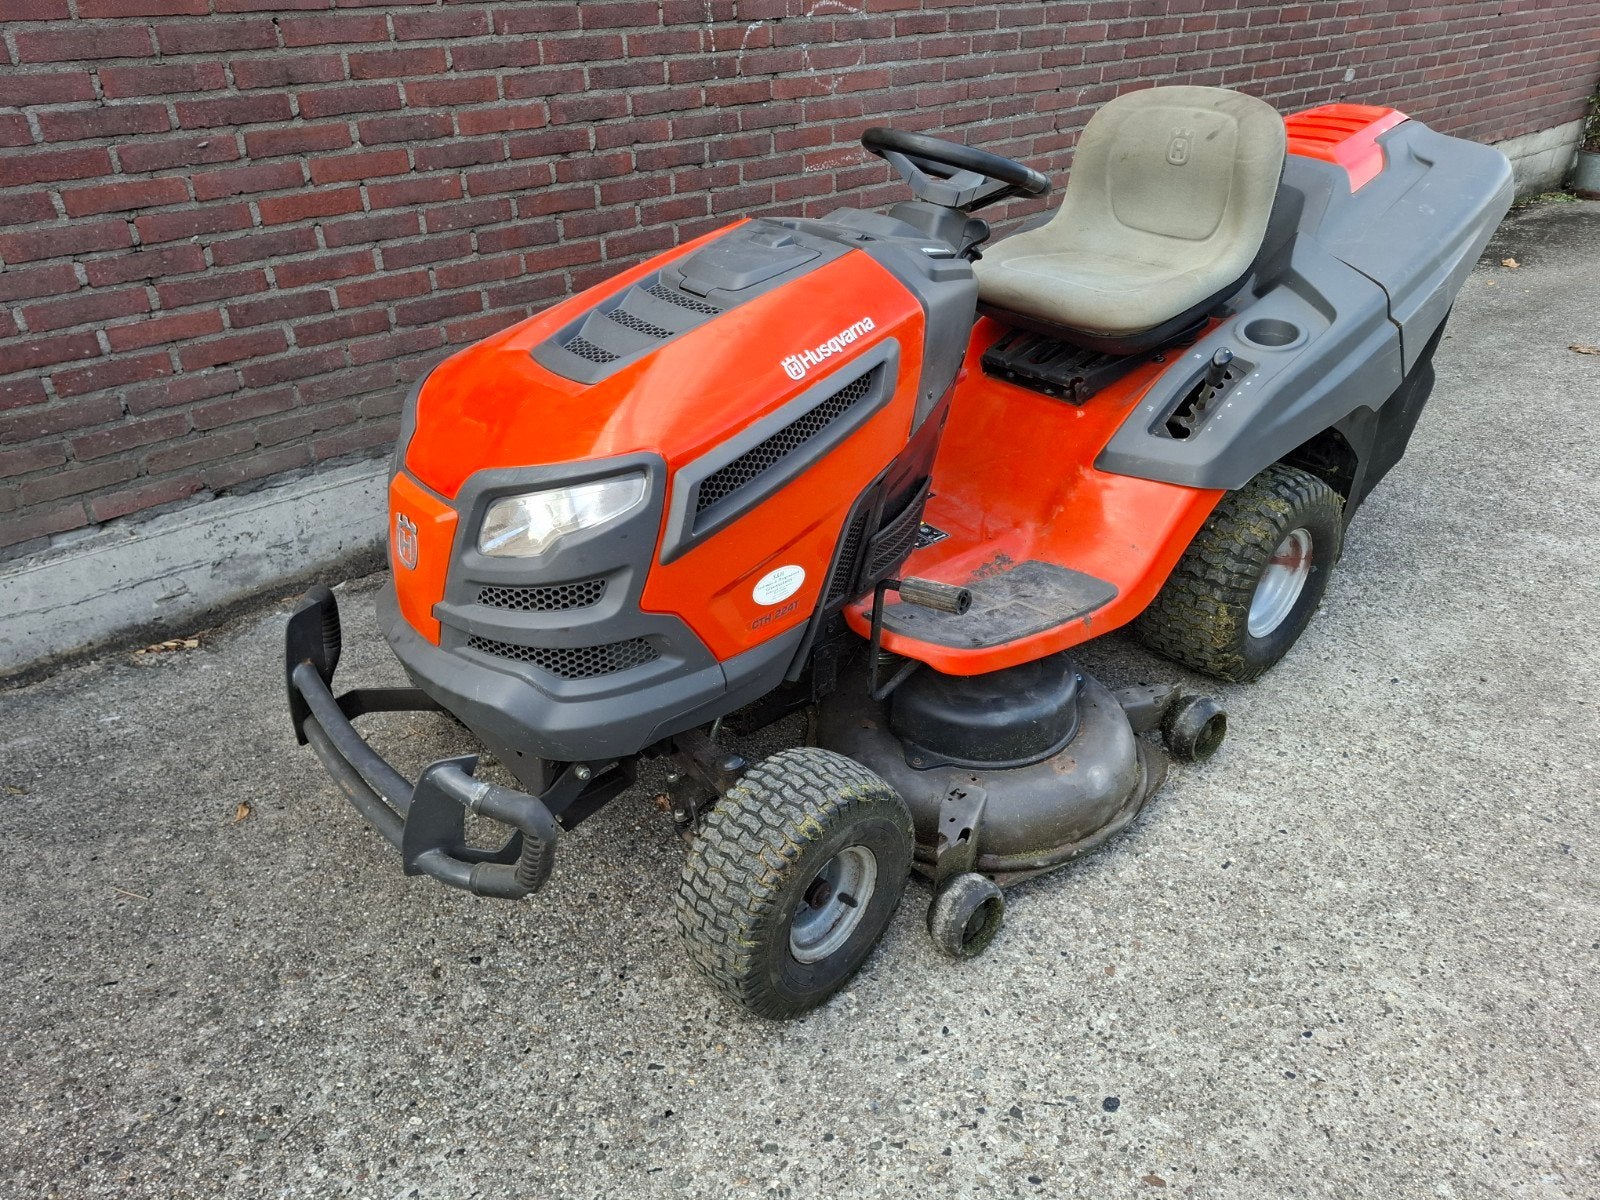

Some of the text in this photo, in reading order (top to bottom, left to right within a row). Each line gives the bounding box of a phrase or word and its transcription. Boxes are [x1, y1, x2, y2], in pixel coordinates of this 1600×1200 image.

[798, 316, 875, 370] Husqvarna
[752, 600, 800, 630] CTH 224T
